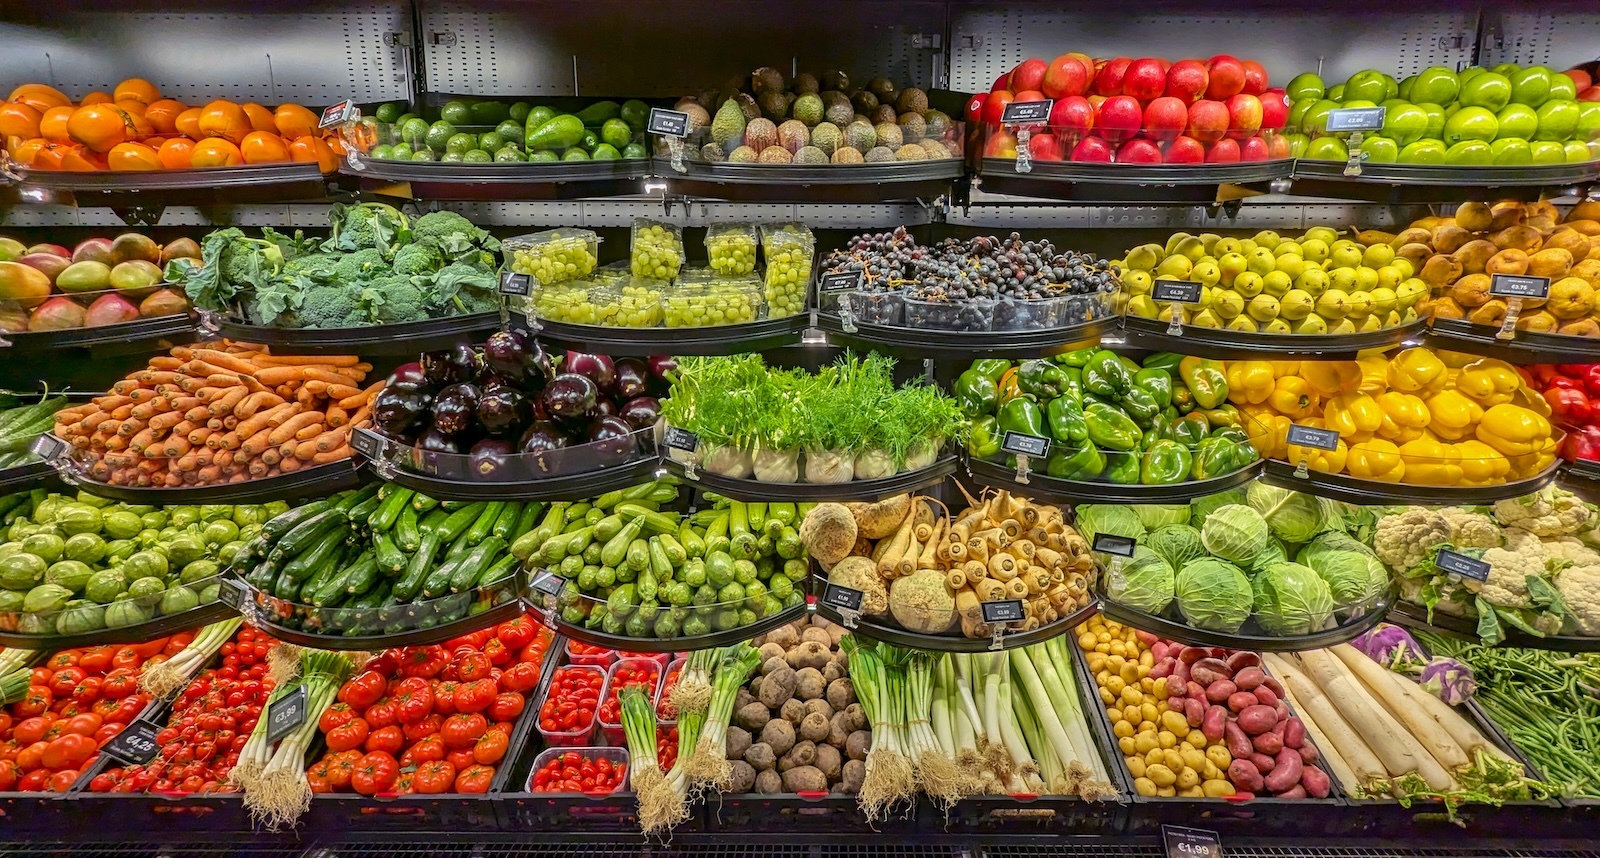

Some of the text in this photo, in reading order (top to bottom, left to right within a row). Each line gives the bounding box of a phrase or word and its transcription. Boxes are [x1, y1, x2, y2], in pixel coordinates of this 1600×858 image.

[275, 704, 296, 723] €3,99
[126, 736, 155, 751] €4,25
[1178, 842, 1209, 855] €1,99
